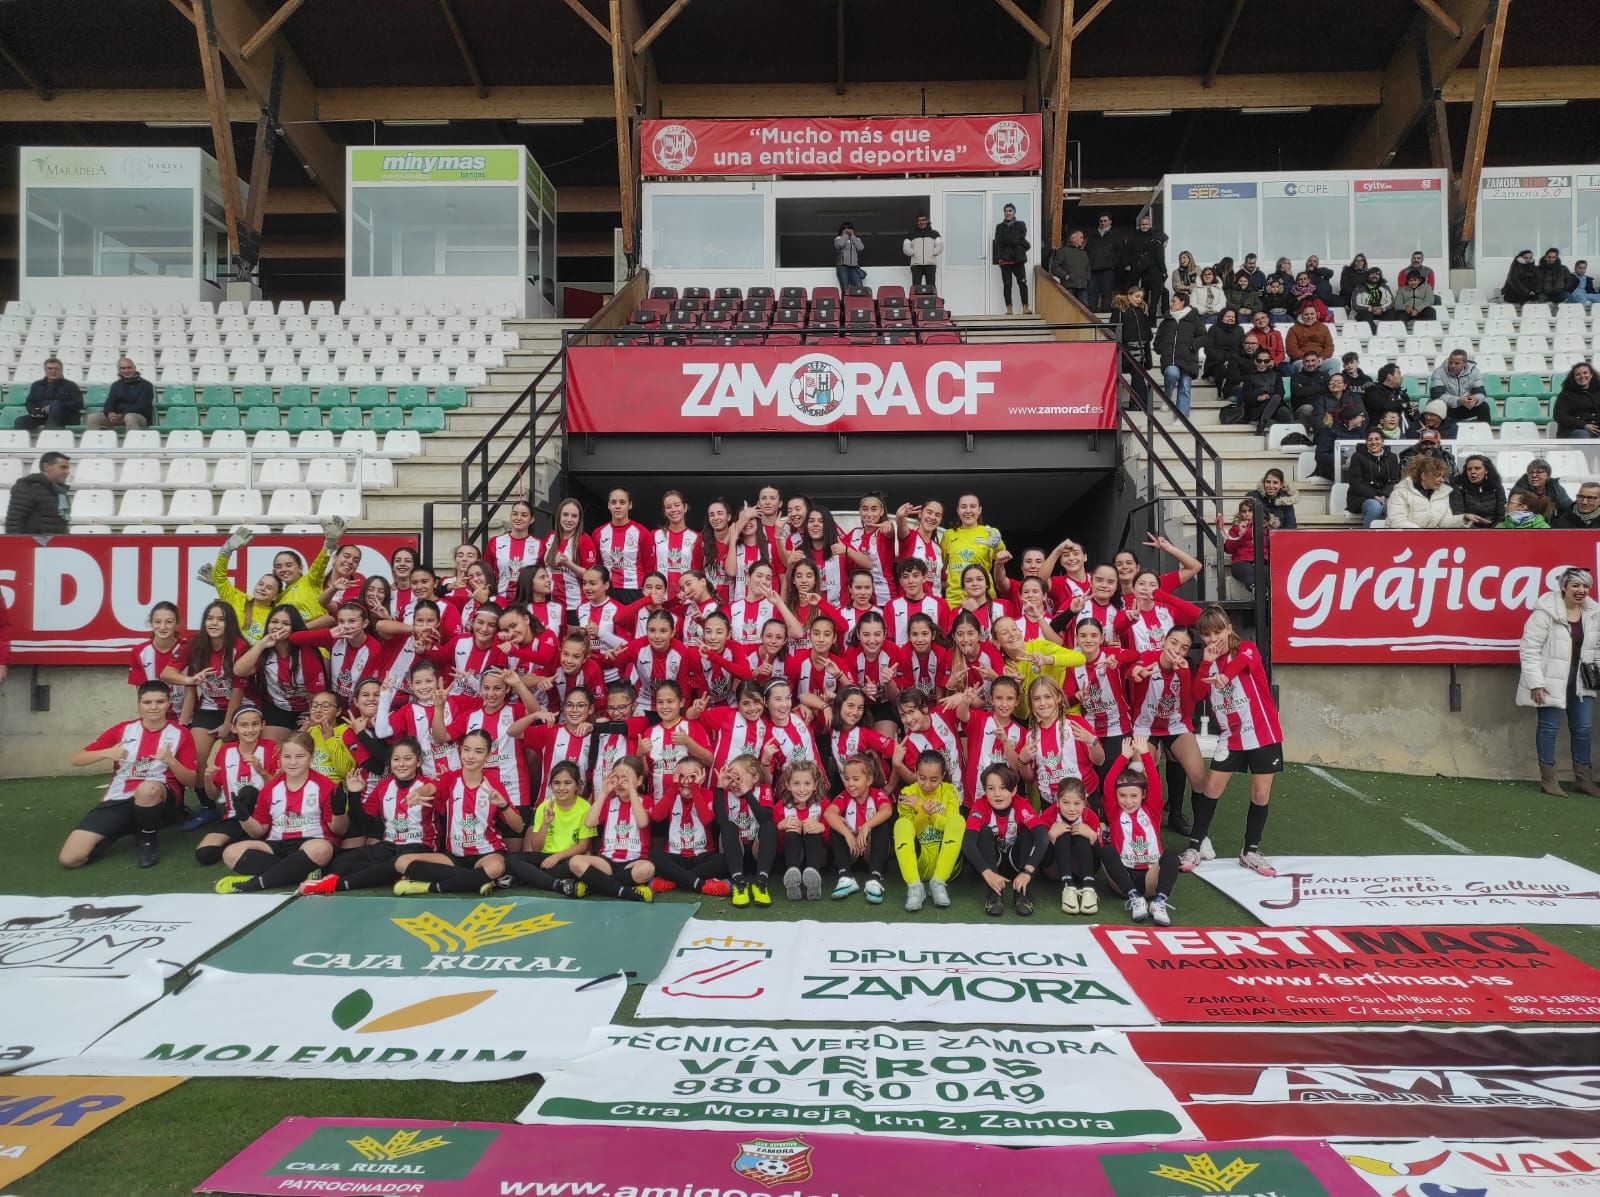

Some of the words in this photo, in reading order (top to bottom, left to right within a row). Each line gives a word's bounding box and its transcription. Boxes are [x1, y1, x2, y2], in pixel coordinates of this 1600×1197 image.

[750, 127, 833, 144] “Mucho
[839, 126, 883, 144] más
[890, 129, 931, 147] que
[382, 152, 486, 174] minymas
[713, 152, 752, 166] una
[759, 147, 842, 165] entidad
[850, 145, 967, 167] deportiva”
[460, 170, 486, 179] tiendas
[1485, 178, 1520, 188] ZAMORA
[1547, 176, 1567, 187] ZN
[1188, 187, 1220, 199] SER
[1297, 184, 1329, 194] COPE
[1492, 189, 1539, 199] Zamora
[1540, 188, 1562, 198] 3.0
[680, 353, 922, 426] ZAMORA
[925, 360, 1001, 416] CF
[1008, 403, 1104, 415] www.zamoracf.es
[1275, 872, 1436, 888] TRANSPORTES
[1363, 882, 1453, 895] Carlos
[1464, 880, 1571, 896] Gallego
[1406, 899, 1445, 907] 647
[1489, 898, 1517, 906] 44
[1526, 899, 1558, 907] 00
[1104, 928, 1551, 956] FERTIMAQ
[291, 952, 404, 970] CAJA
[420, 954, 582, 972] RURAL
[1146, 957, 1366, 970] MAQUINARIA
[1226, 971, 1514, 988] www.fertimaq.es
[801, 975, 1132, 1006] ZAMORA
[1184, 995, 1273, 1004] ZAMORA
[1285, 994, 1351, 1003] Camino
[1352, 995, 1380, 1003] San
[1206, 1006, 1335, 1016] BENAVENTE
[1348, 1005, 1366, 1015] C/
[1508, 1005, 1544, 1015] 980
[607, 1032, 779, 1053] TÉCNICA
[791, 1033, 926, 1052] VERDE
[938, 1035, 1119, 1055] ZAMORA
[137, 1043, 528, 1063] MOLENDUM
[672, 1077, 781, 1095] 980
[807, 1079, 912, 1101] 160
[936, 1080, 1045, 1104] 049
[609, 1104, 688, 1117] Ctra.
[704, 1104, 861, 1123] Moraleja,
[875, 1113, 924, 1127] km
[938, 1116, 966, 1130] 2,
[980, 1115, 1115, 1131] Zamora
[286, 1162, 340, 1171] CAJA
[348, 1163, 426, 1174] RURAL
[1457, 1150, 1600, 1173] VAL
[278, 1179, 425, 1194] PATROCINADOR
